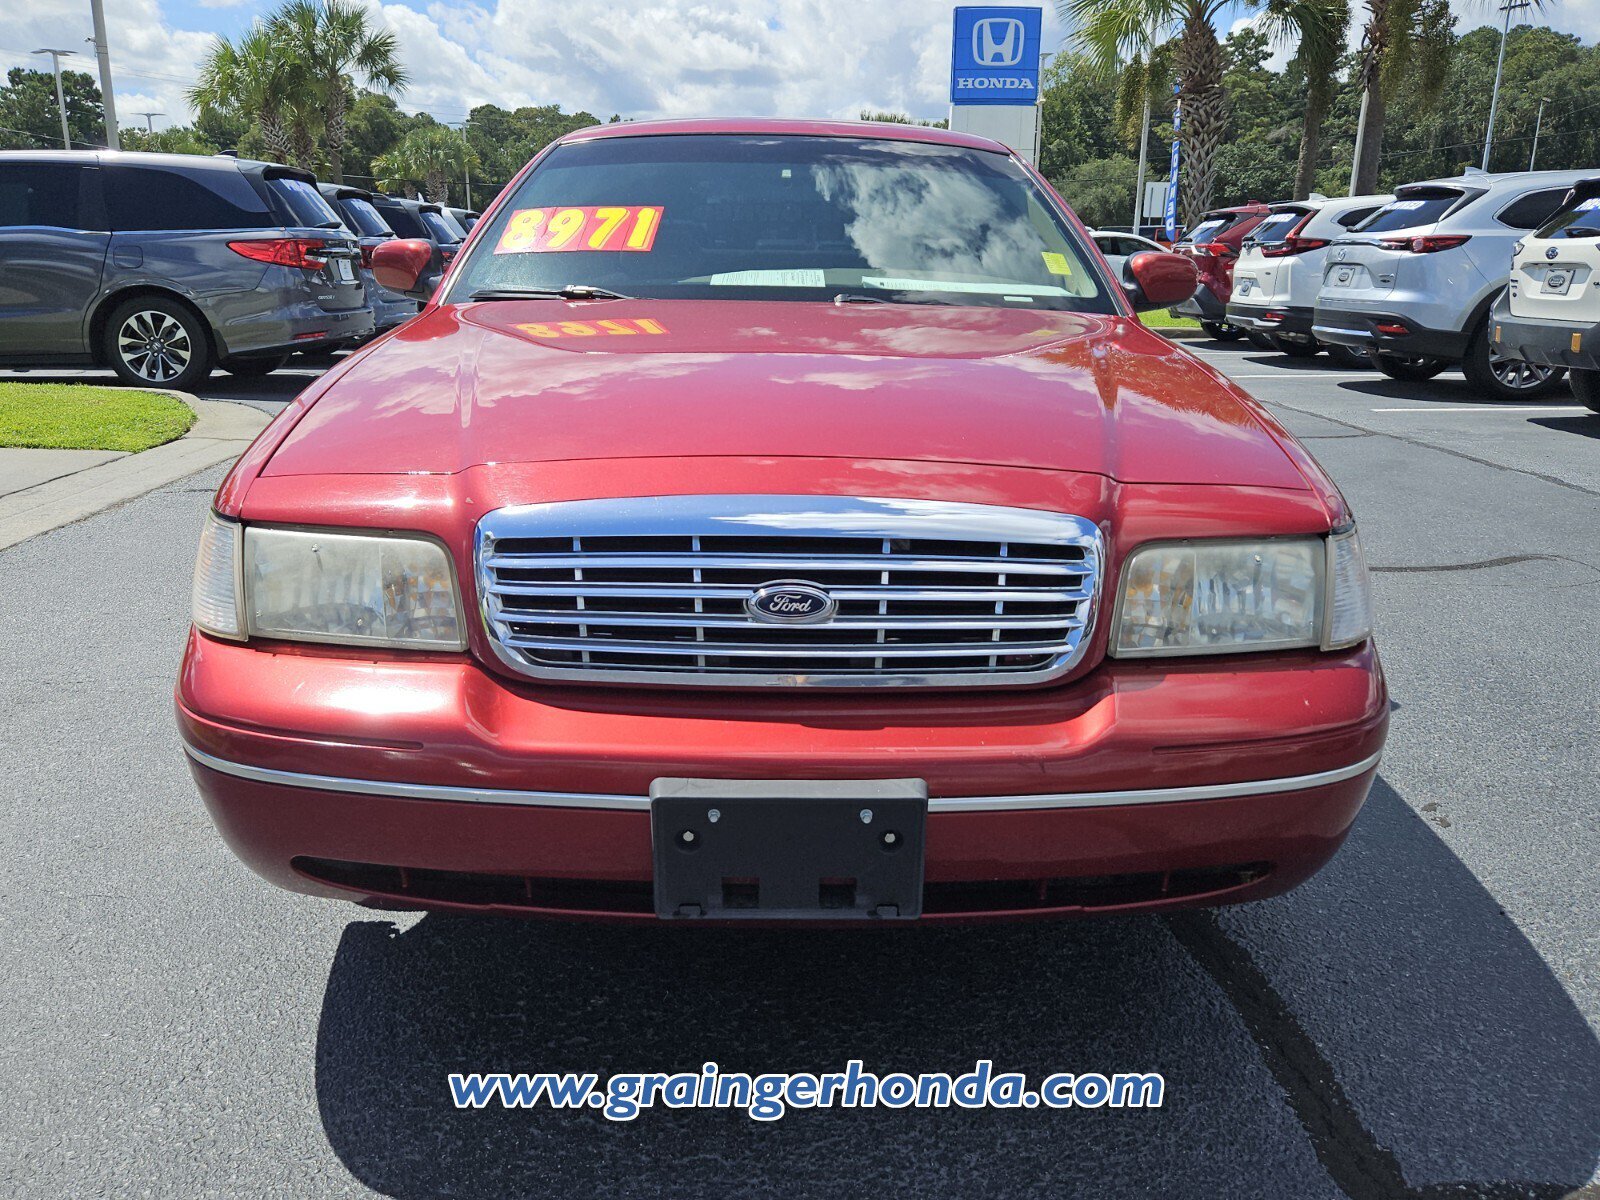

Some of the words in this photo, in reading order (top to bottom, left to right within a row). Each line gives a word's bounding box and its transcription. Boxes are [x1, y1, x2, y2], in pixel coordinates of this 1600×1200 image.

[957, 77, 1034, 89] HONDA
[502, 207, 659, 250] 8971
[769, 594, 812, 612] Ford
